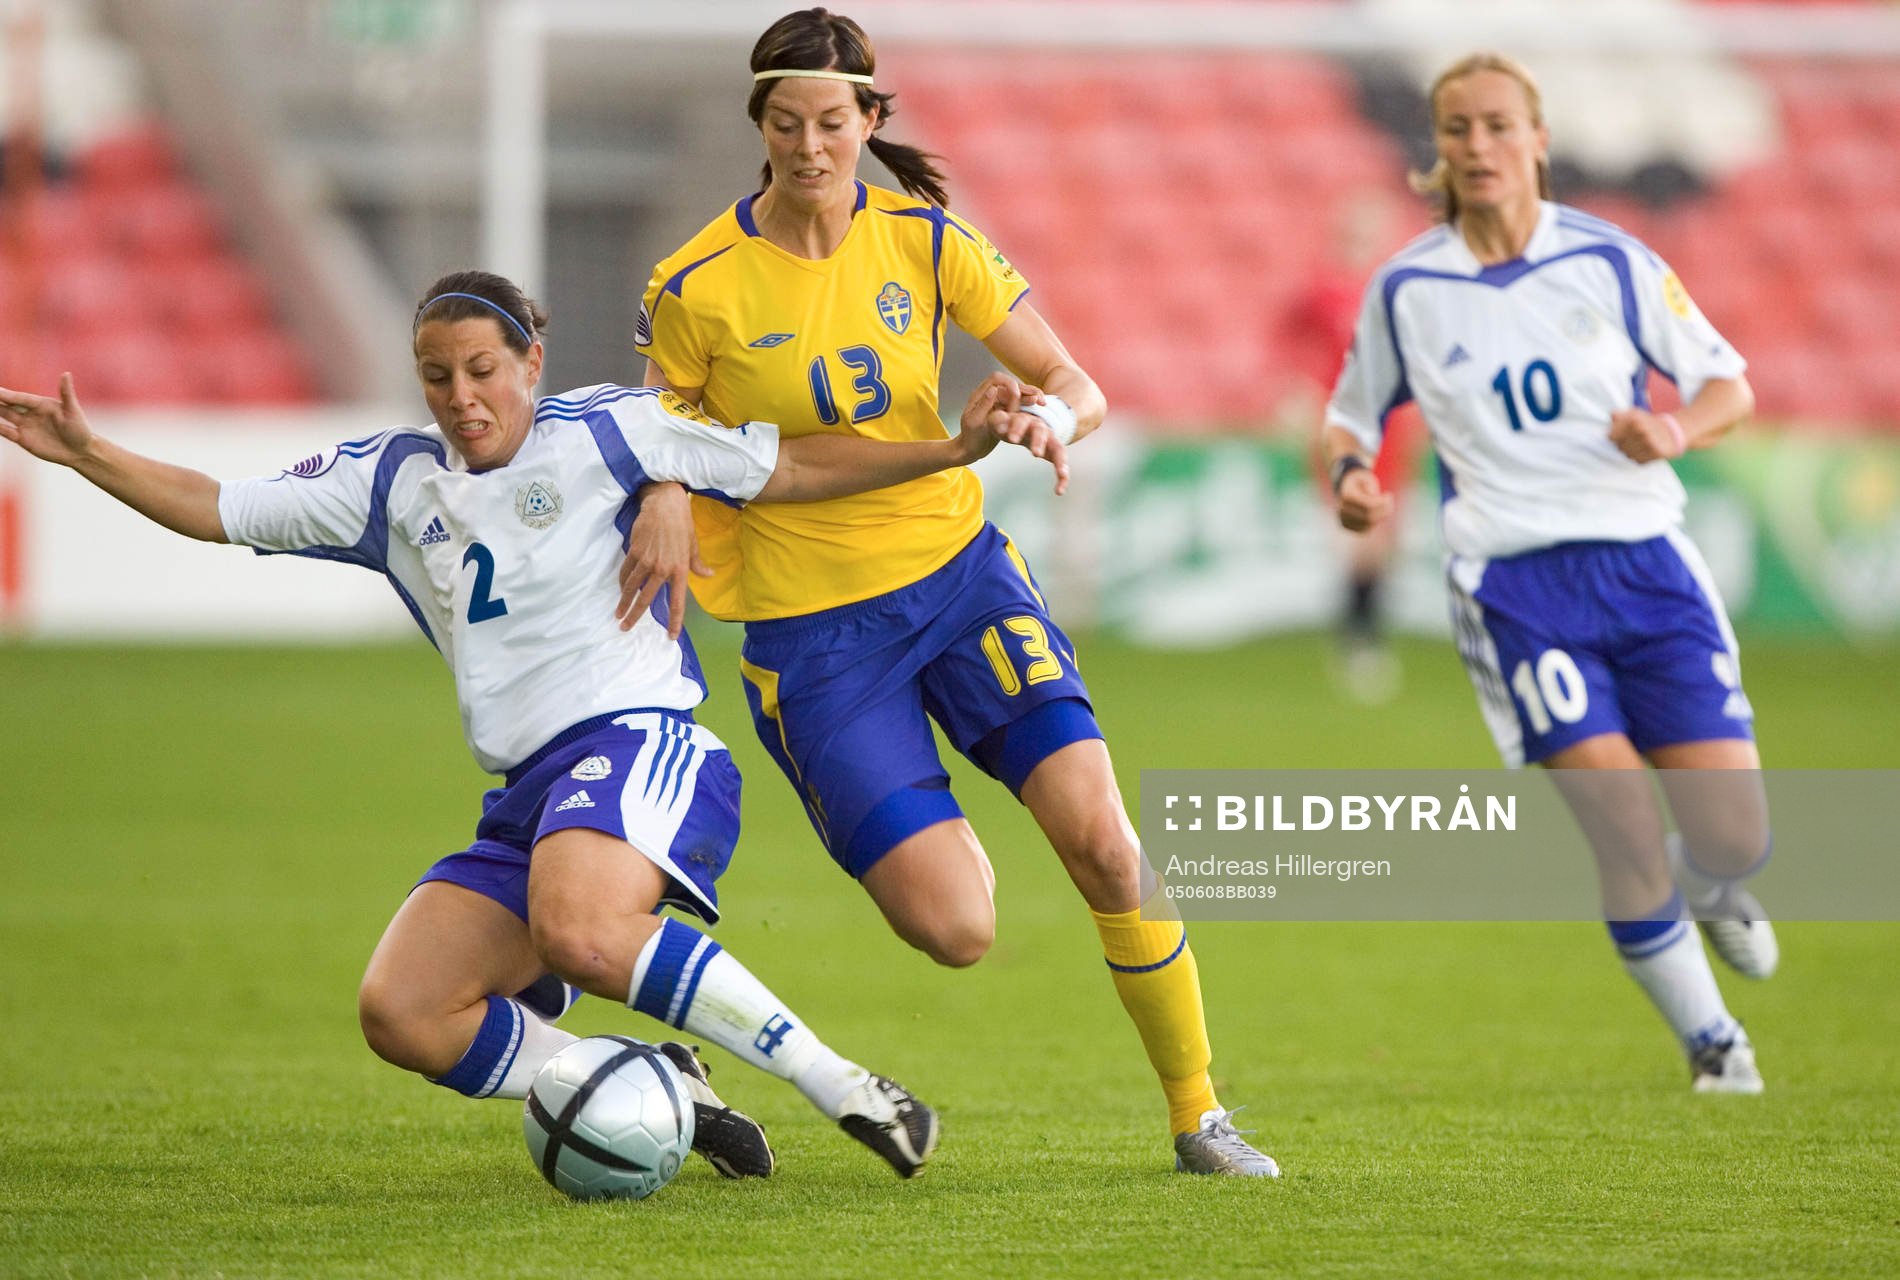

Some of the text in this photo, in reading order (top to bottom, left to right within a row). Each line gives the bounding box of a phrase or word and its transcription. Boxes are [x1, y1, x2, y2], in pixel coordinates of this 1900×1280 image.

[808, 344, 892, 425] 13
[1492, 360, 1561, 431] 10
[419, 533, 451, 546] adidas
[462, 542, 508, 624] 2
[981, 615, 1064, 696] 13
[1511, 648, 1588, 735] 10
[555, 801, 596, 812] adidas
